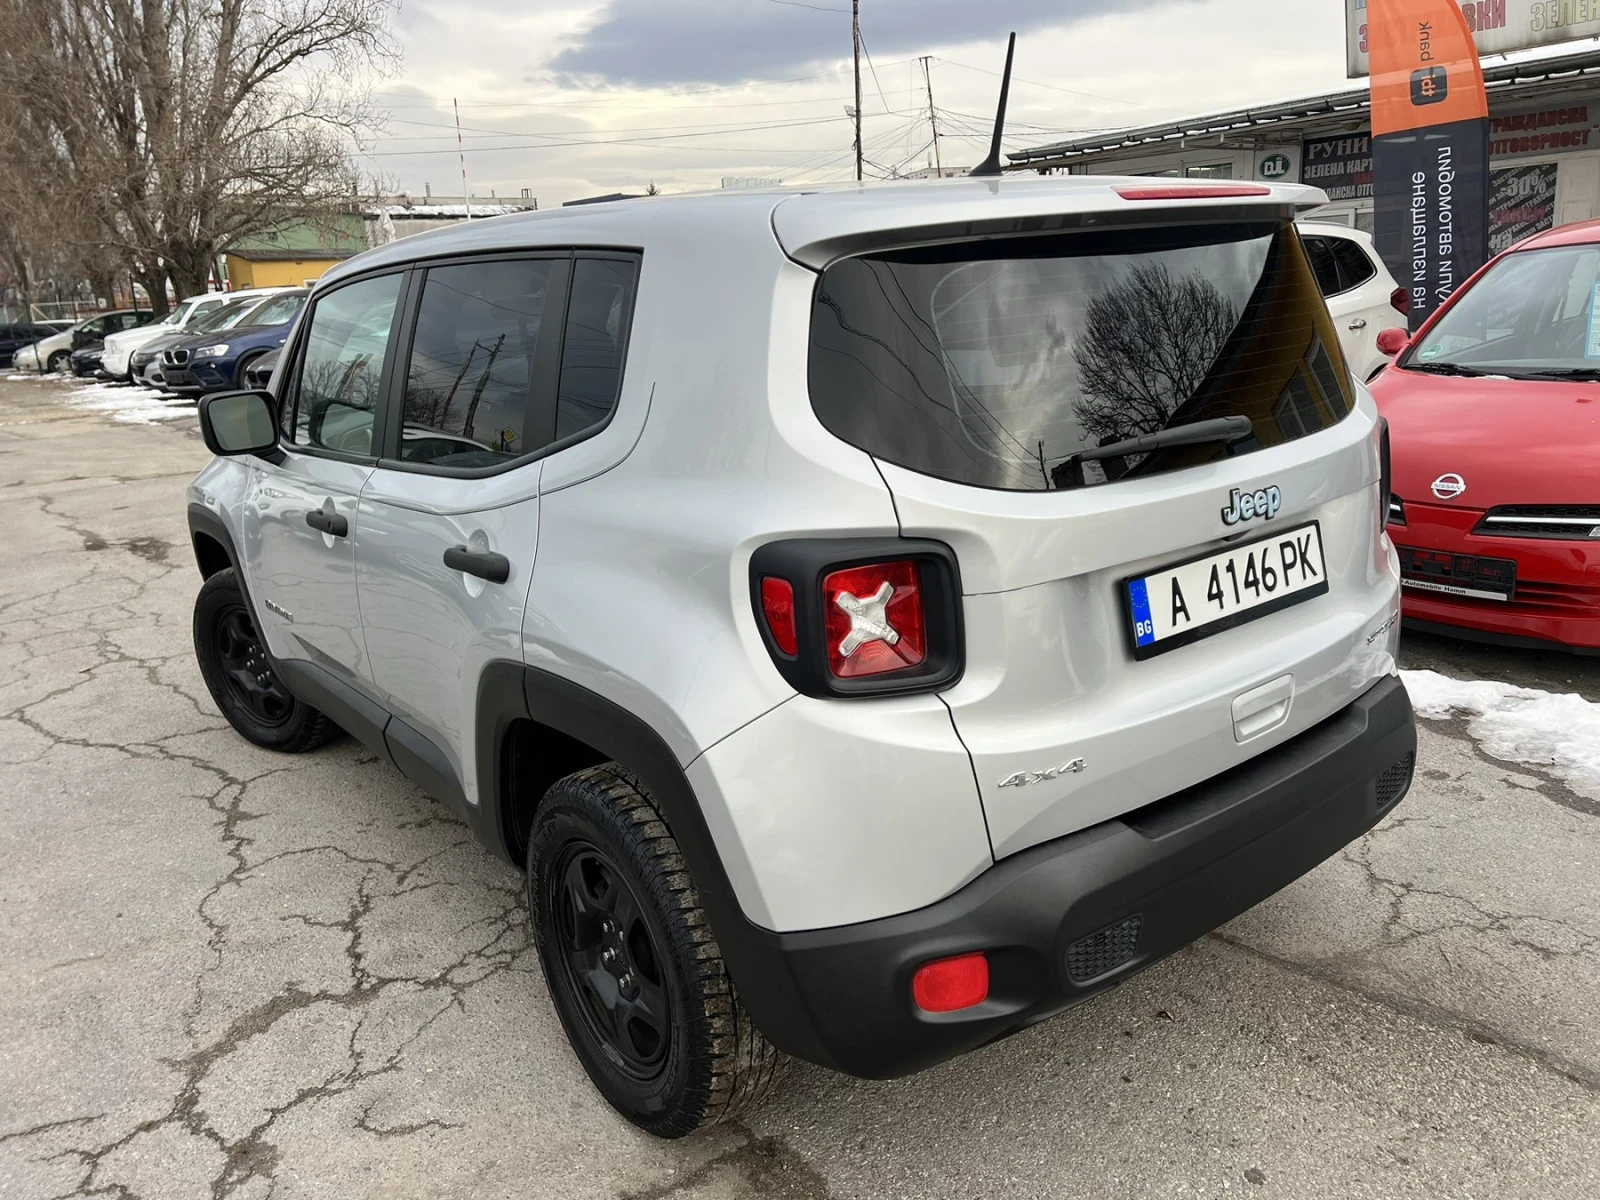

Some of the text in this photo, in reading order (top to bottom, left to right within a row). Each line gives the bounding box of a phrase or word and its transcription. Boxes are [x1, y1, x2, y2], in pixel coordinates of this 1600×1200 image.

[1304, 161, 1345, 179] ЗЕЛЕНА
[1325, 184, 1356, 199] ДАНСКА
[1500, 174, 1547, 197] -30%
[1222, 485, 1281, 526] Jeep
[1171, 533, 1318, 627] A 4146 PK
[1405, 580, 1467, 595] Automobile Hamm
[1136, 619, 1152, 638] BG
